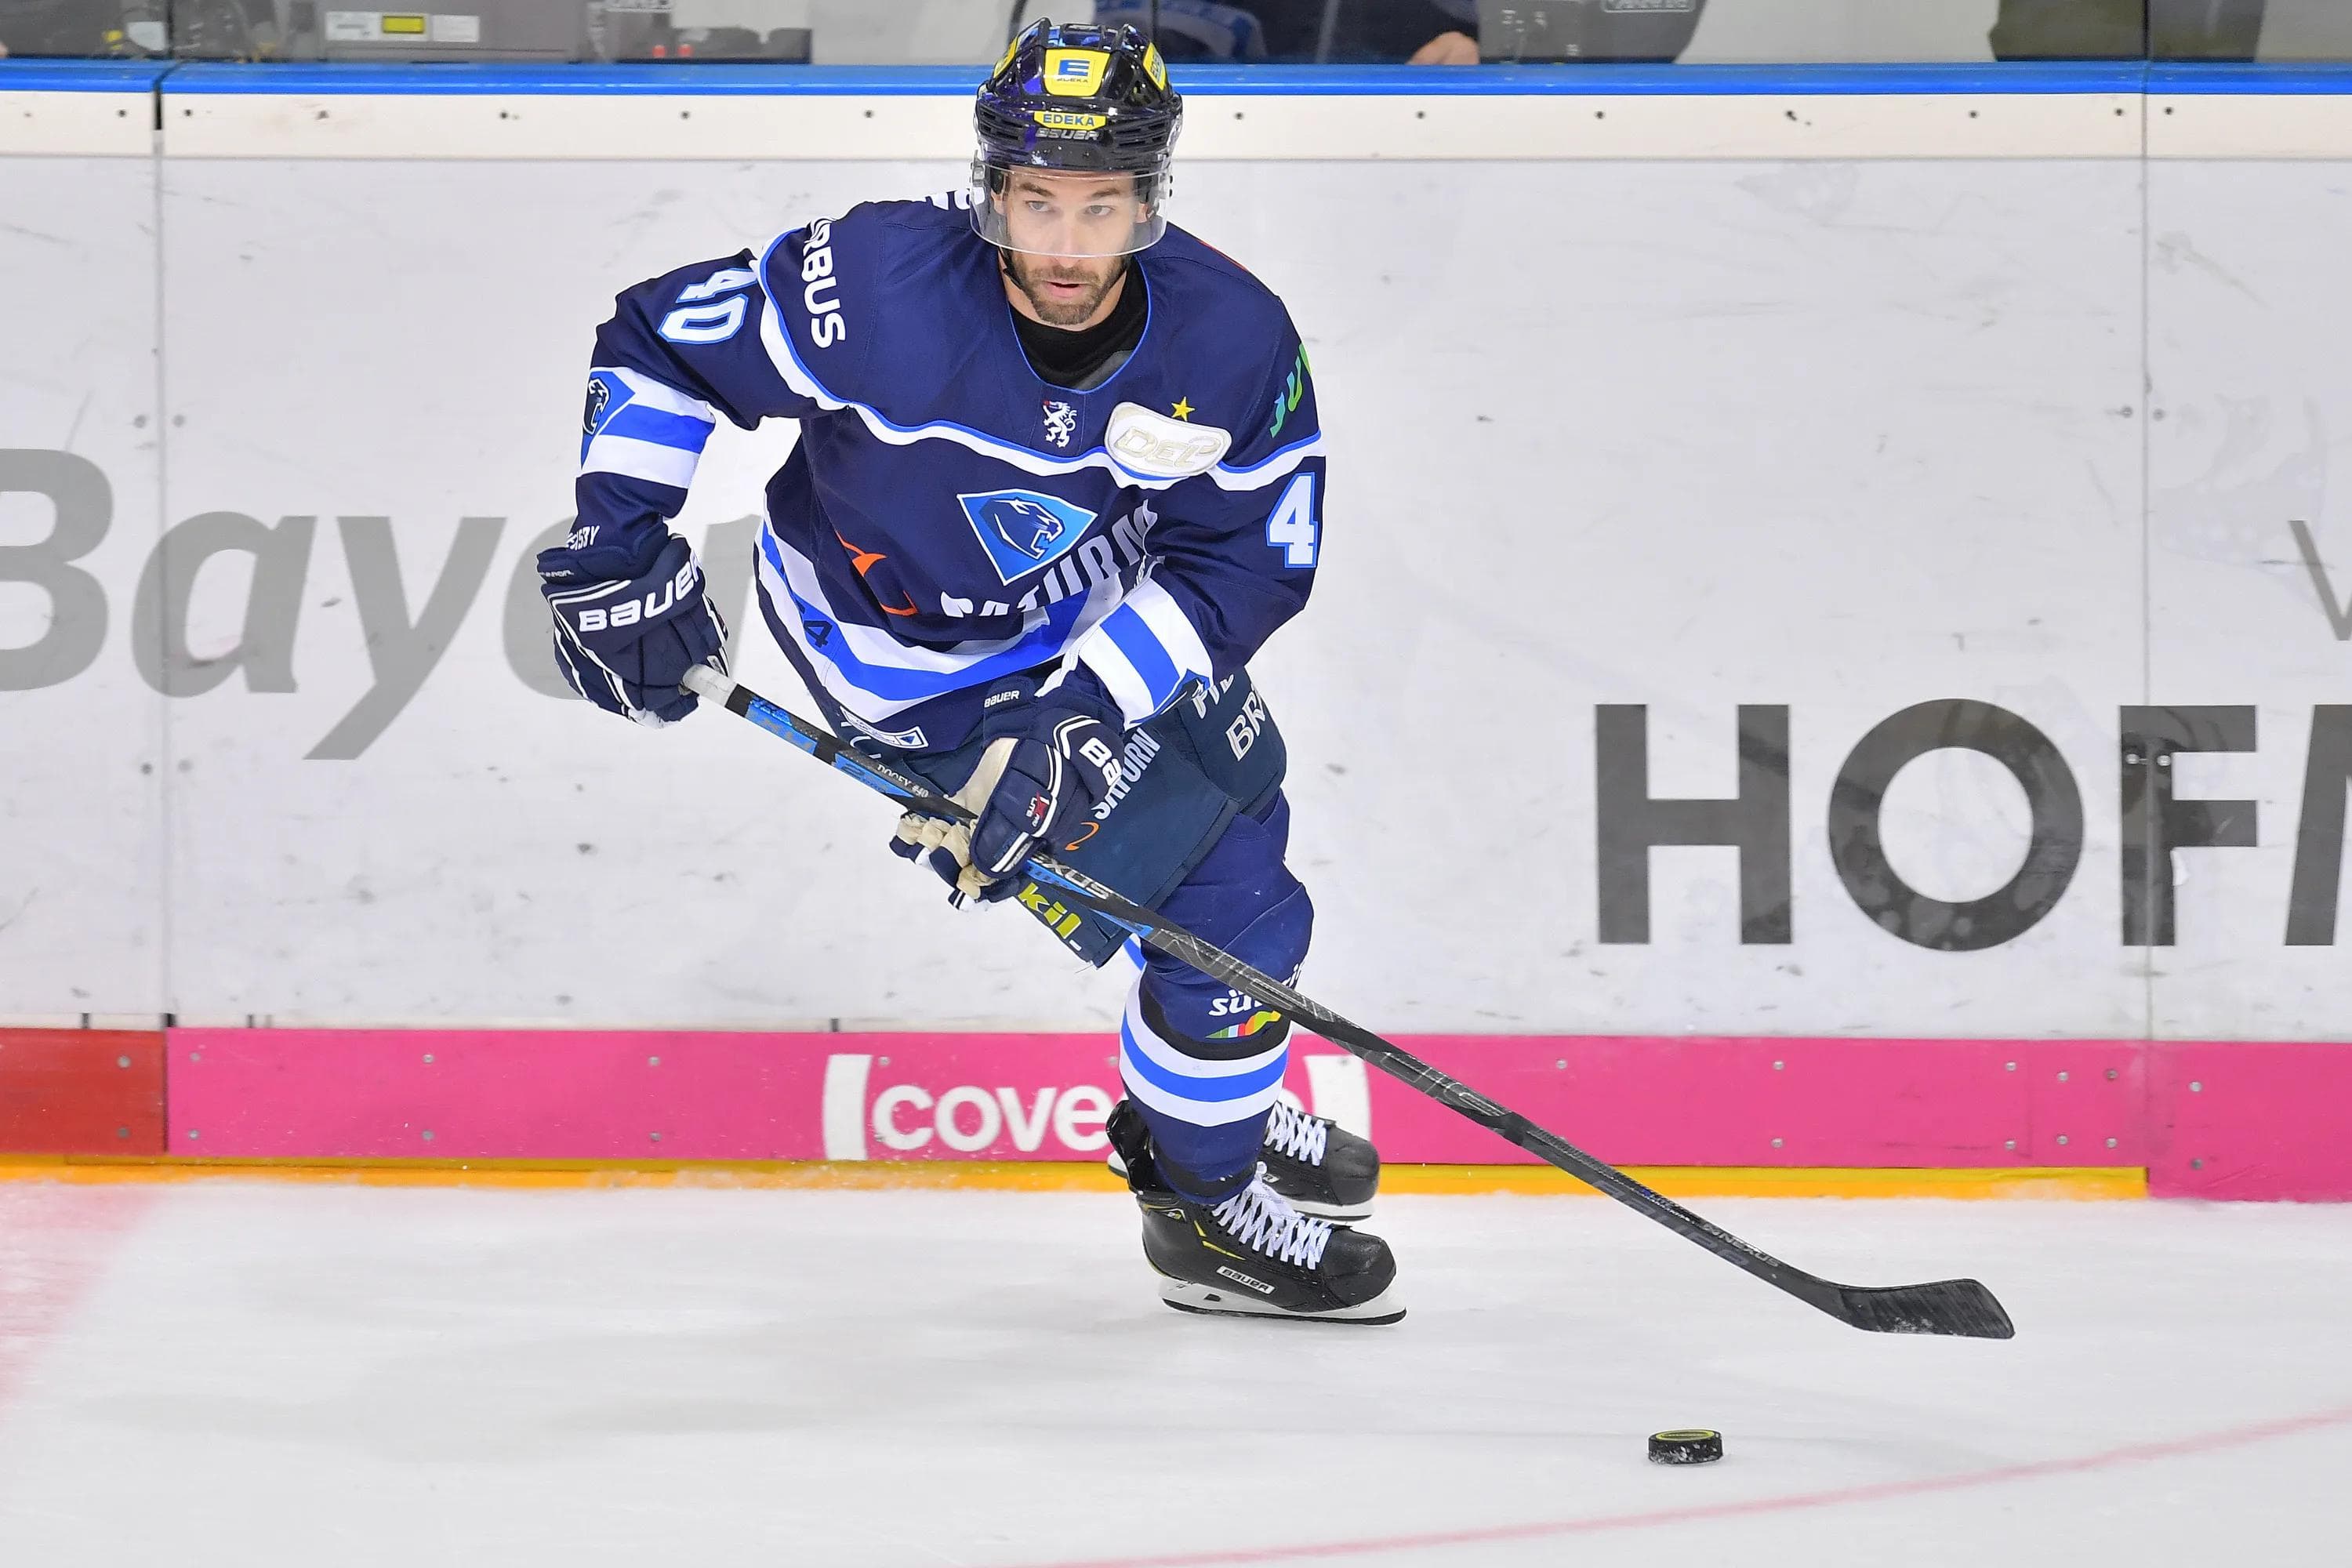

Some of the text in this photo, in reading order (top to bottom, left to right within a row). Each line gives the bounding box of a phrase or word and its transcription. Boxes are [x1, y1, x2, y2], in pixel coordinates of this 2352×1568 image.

[1043, 114, 1094, 126] EDEKA
[657, 268, 757, 344] 40
[1265, 472, 1319, 568] 4
